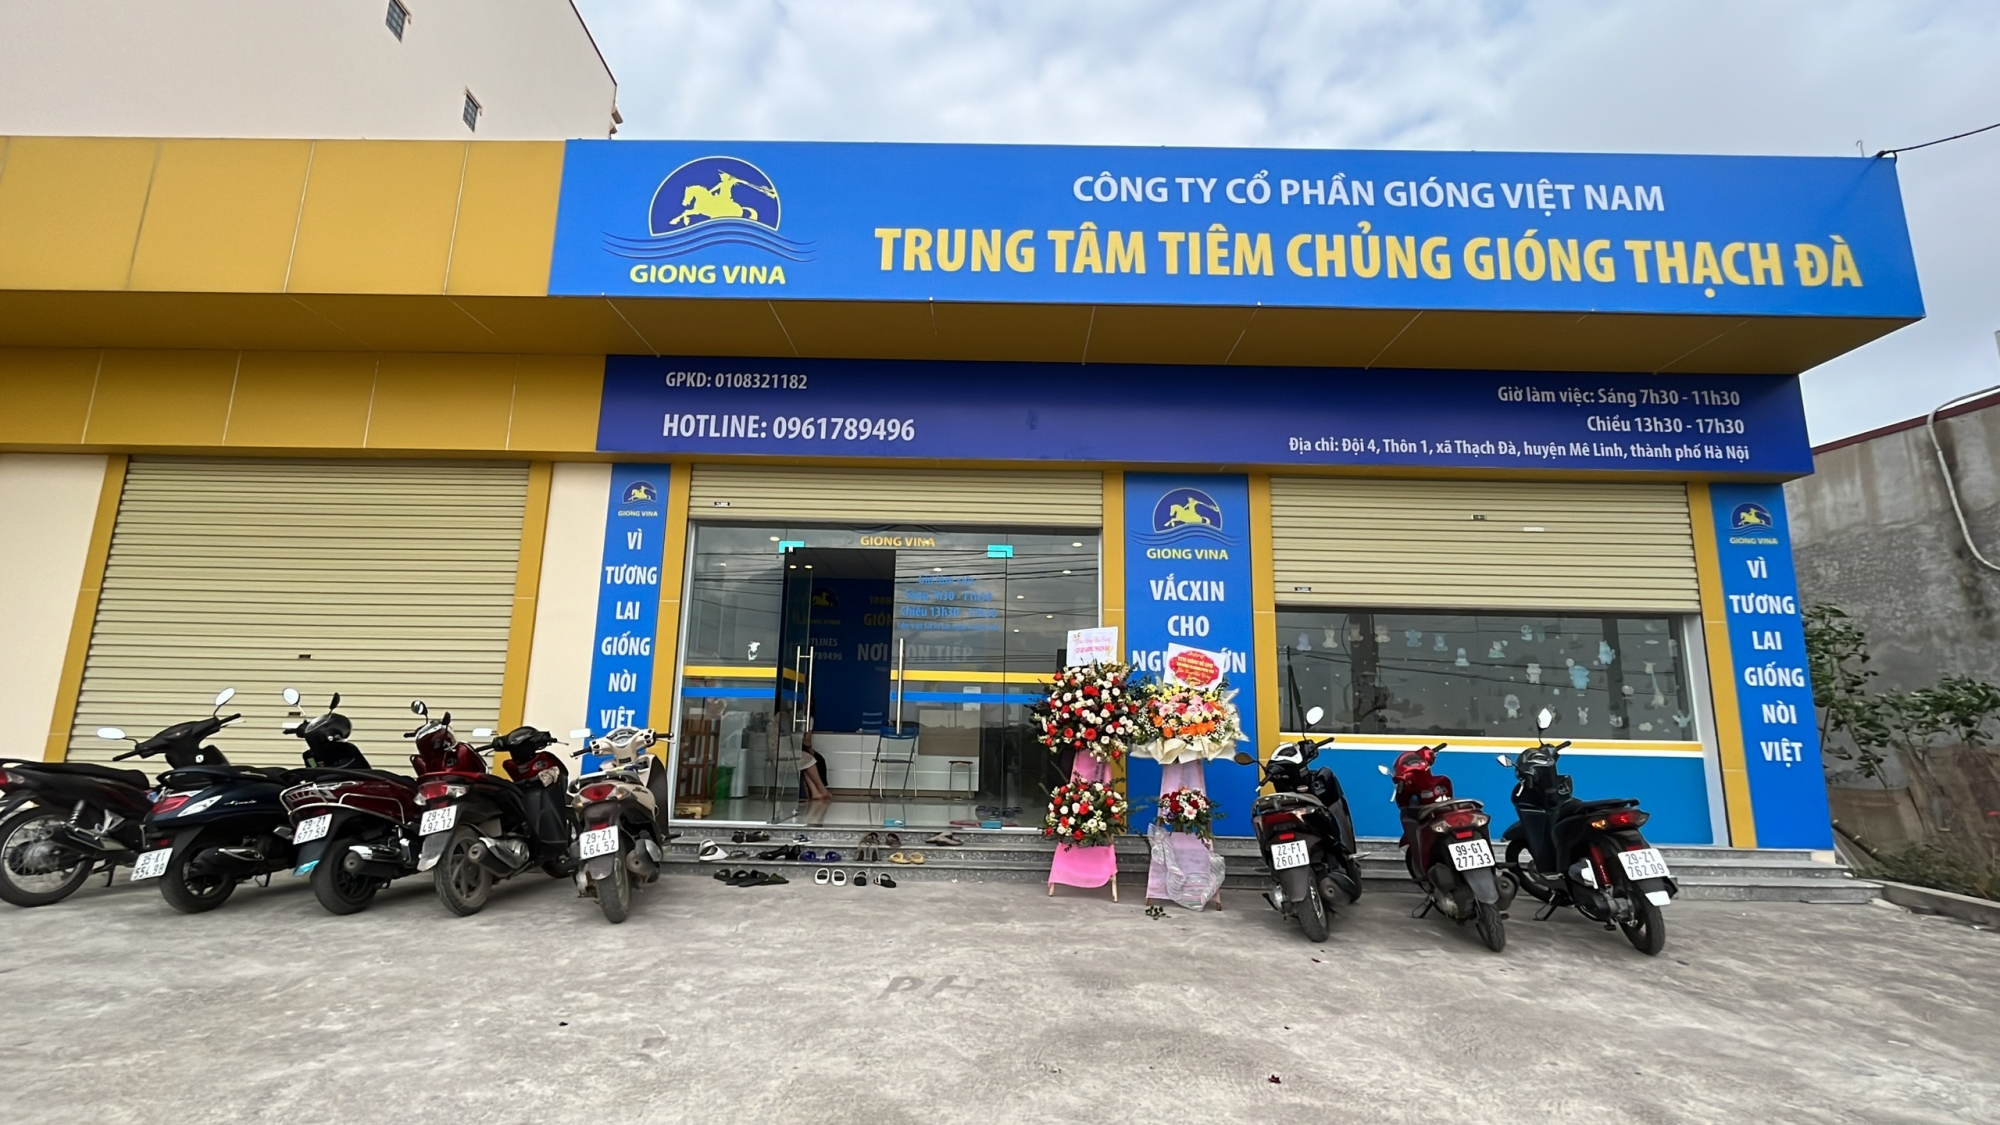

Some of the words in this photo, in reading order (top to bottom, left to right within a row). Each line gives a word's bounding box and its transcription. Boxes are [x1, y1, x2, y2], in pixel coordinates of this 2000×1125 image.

[1074, 171, 1167, 203] CÔNG
[1176, 178, 1217, 203] TY
[1226, 170, 1270, 204] CỔ
[1281, 173, 1374, 206] PHẦN
[1384, 177, 1494, 208] GIÓNG
[1501, 179, 1574, 216] VIỆT
[1584, 185, 1665, 212] NAM
[875, 228, 1034, 273] TRUNG
[1048, 222, 1146, 274] TÂM
[1158, 224, 1273, 276] TIÊM
[1287, 221, 1451, 280] CHỦNG
[1464, 229, 1615, 282] GIÓNG
[1625, 240, 1783, 298] THẠCH
[1794, 235, 1863, 287] ĐÀ
[630, 264, 716, 284] GIONG
[723, 265, 785, 285] VINA
[666, 372, 711, 388] GPKD:
[715, 373, 808, 389] 0108321182
[1498, 386, 1524, 402] Giờ
[1527, 387, 1555, 403] làm
[1559, 387, 1594, 407] việc:
[1597, 387, 1637, 407] Sáng
[1640, 389, 1678, 405] 7h30
[1692, 390, 1740, 406] 11h30
[663, 413, 767, 439] HOTLINE:
[773, 416, 915, 441] 0961789496
[1586, 415, 1631, 432] Chiều
[1635, 416, 1683, 433] 13h30
[1696, 418, 1745, 435] 17h30
[1289, 437, 1311, 455] Địa
[1315, 437, 1339, 452] chỉ:
[1342, 438, 1364, 455] Đội
[1367, 440, 1381, 454] 4,
[1383, 439, 1417, 453] Thôn
[1420, 440, 1433, 455] 1,
[1436, 440, 1452, 453] xã
[1455, 440, 1495, 457] Thạch
[1498, 441, 1521, 457] Đà,
[1524, 441, 1566, 459] huyện
[1569, 442, 1590, 457] Mê
[1593, 443, 1628, 459] Linh,
[1630, 443, 1672, 458] thành
[1675, 443, 1702, 461] phố
[1704, 445, 1723, 459] Hà
[1726, 445, 1750, 463] Nội
[627, 527, 643, 550] VÌ
[860, 535, 902, 547] GIONG
[905, 537, 936, 547] VINA
[1146, 548, 1192, 560] GIONG
[1195, 548, 1229, 560] VINA
[605, 565, 657, 585] TƯƠNG
[1746, 557, 1768, 578] VÌ
[1150, 573, 1225, 602] VẮCXIN
[616, 600, 640, 620] LAI
[1728, 593, 1796, 615] TƯƠNG
[1167, 615, 1210, 637] CHO
[601, 634, 651, 656] GIỐNG
[1752, 631, 1783, 650] LAI
[608, 671, 636, 692] NÒI
[1744, 661, 1805, 688] GIỐNG
[1761, 703, 1797, 725] NÒI
[1760, 740, 1803, 768] VIỆT
[585, 829, 612, 845] 29-Z1
[583, 840, 616, 856] 464.52
[1276, 842, 1301, 856] 22-F1
[1455, 842, 1483, 857] 99-G1
[1456, 853, 1491, 868] 277.33
